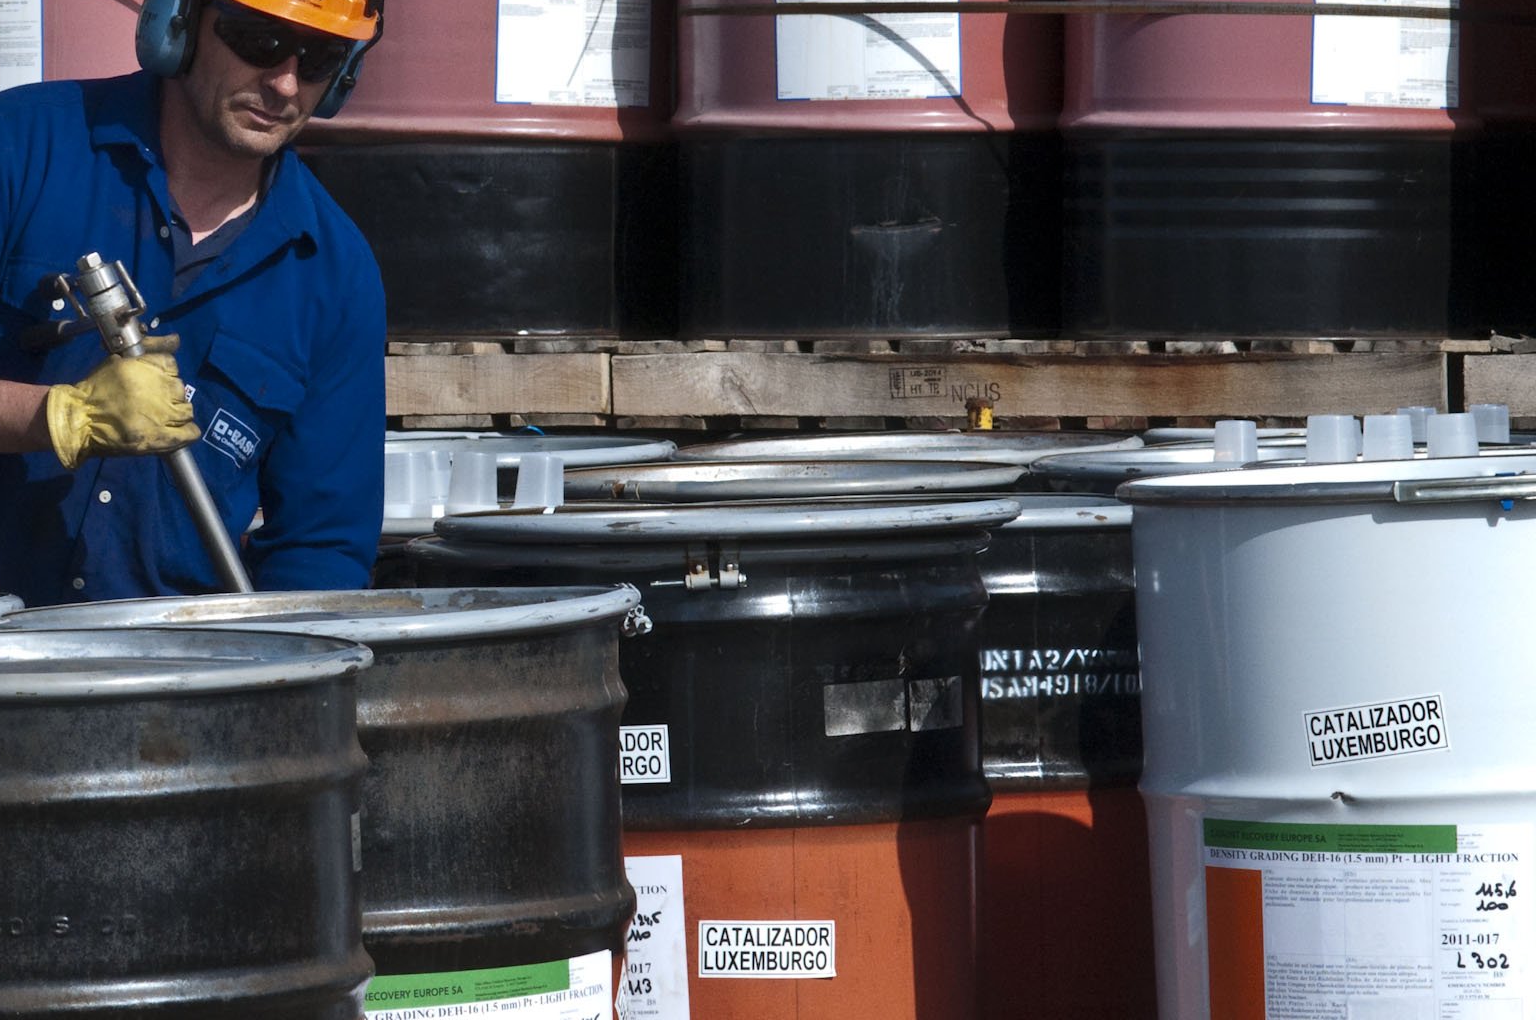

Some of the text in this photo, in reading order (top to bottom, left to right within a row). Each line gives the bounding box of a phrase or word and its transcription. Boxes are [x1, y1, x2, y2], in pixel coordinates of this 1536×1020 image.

[1310, 699, 1441, 737] CATALIZADOR
[1311, 724, 1442, 762] LUXEMBURGO
[1281, 834, 1312, 843] EUROPE
[1315, 834, 1326, 844] SA
[1210, 848, 1247, 860] DENSITY
[1250, 851, 1299, 862] GRADING
[1302, 853, 1341, 863] DEH-16
[1343, 854, 1362, 864] (1.5
[1365, 854, 1389, 864] mm)
[1392, 854, 1403, 864] Pt
[1413, 853, 1453, 864] LIGHT
[1456, 852, 1519, 864] FRACTION
[1476, 900, 1509, 912] 100
[706, 926, 831, 947] CATALIZADOR
[1441, 933, 1500, 946] 2011-017
[704, 950, 828, 971] LUXEMBURGO
[413, 988, 450, 998] EUROPE
[452, 985, 464, 995] SA
[374, 1008, 436, 1020] GRADING
[438, 1003, 479, 1018] DEH-16
[523, 996, 533, 1008] Pt
[540, 991, 567, 1007] LIGHT
[569, 983, 604, 1001] FRACTION
